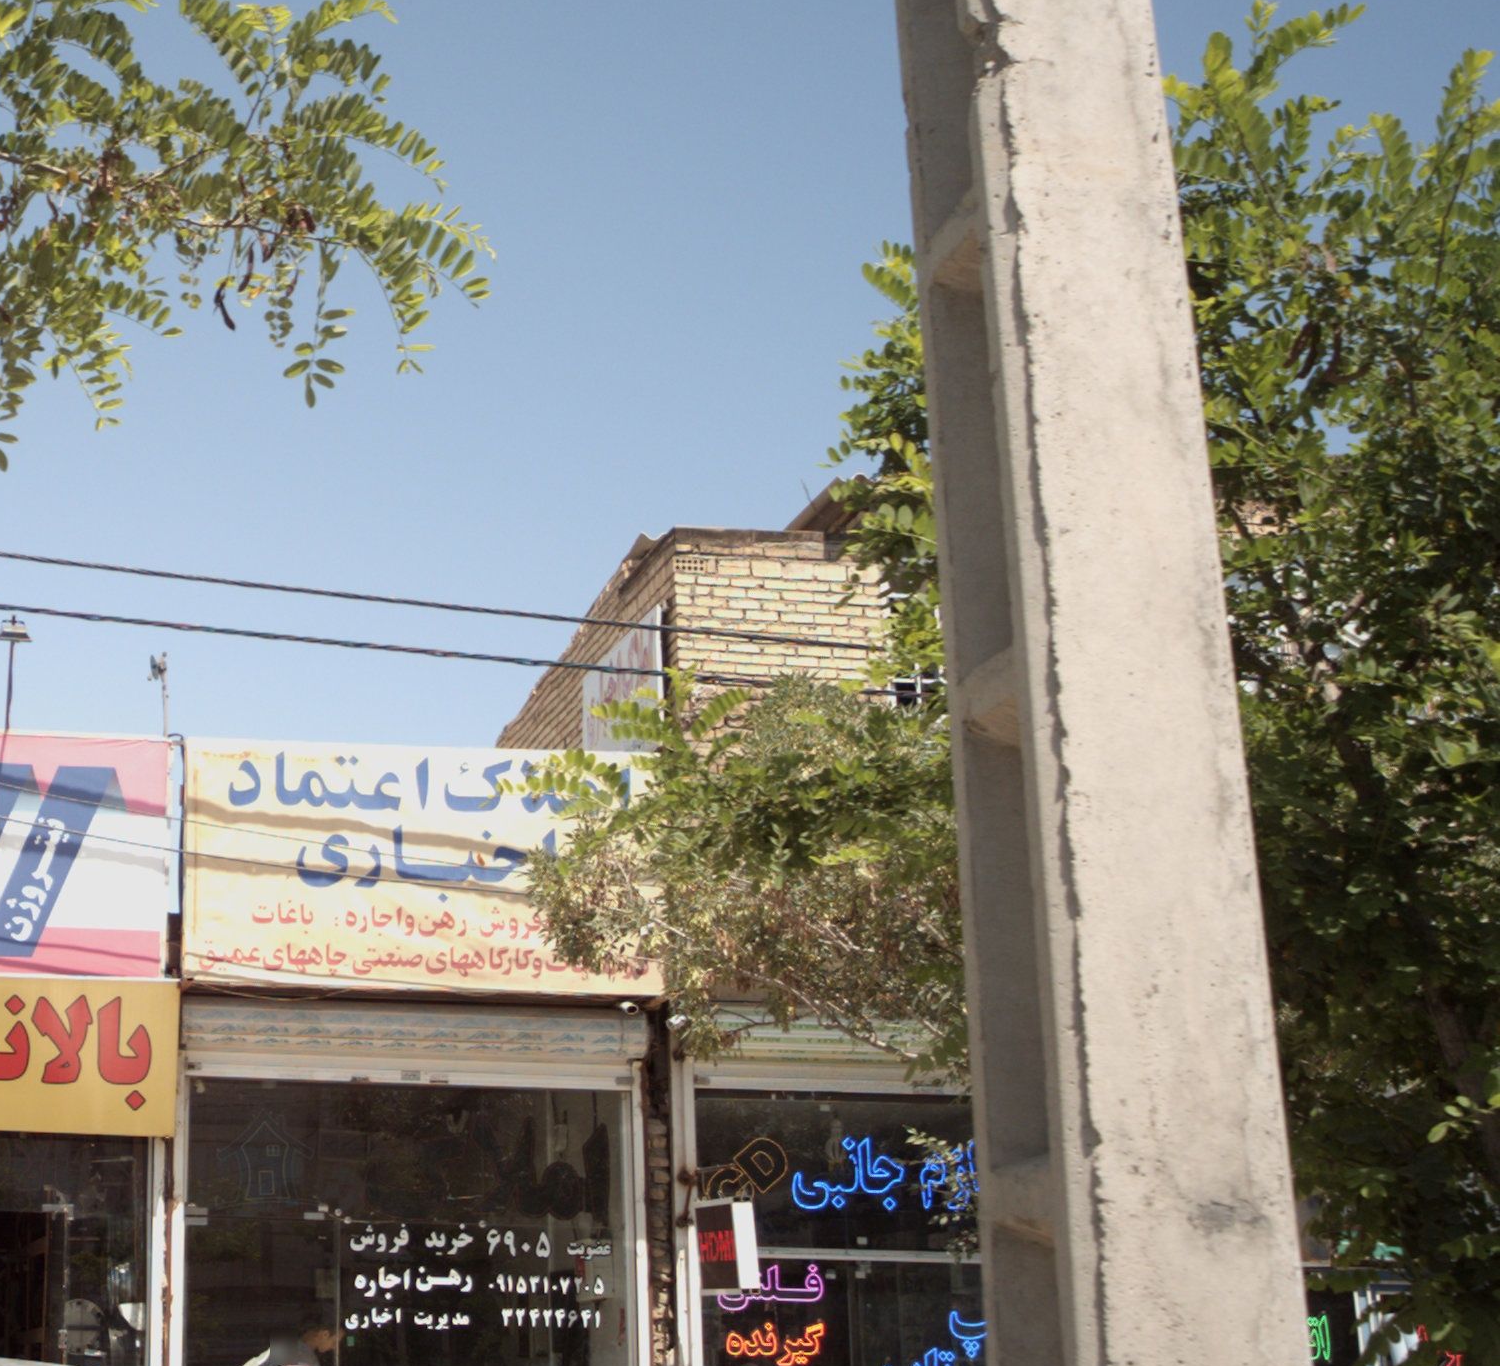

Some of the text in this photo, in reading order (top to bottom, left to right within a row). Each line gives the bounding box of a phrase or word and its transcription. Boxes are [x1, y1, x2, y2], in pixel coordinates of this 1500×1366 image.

[227, 751, 430, 812] اعتماد
[5, 817, 70, 941] نیتروژن
[251, 899, 314, 934] باغات
[418, 910, 467, 937] رهن
[198, 940, 260, 971] عمیق
[352, 946, 424, 976] صنعتی
[791, 1135, 905, 1211] جانبی
[349, 1223, 474, 1256] خرید فروش
[486, 1228, 612, 1260] عضویت ۶۹۰۵
[354, 1266, 473, 1300] رهن اجاره
[488, 1272, 605, 1295] ۰۹۱۵۳۱۰۷۲۰۵
[344, 1307, 471, 1330] مدیریت اخباری
[501, 1307, 601, 1329] ۳۲۴۲۴۶۴۱
